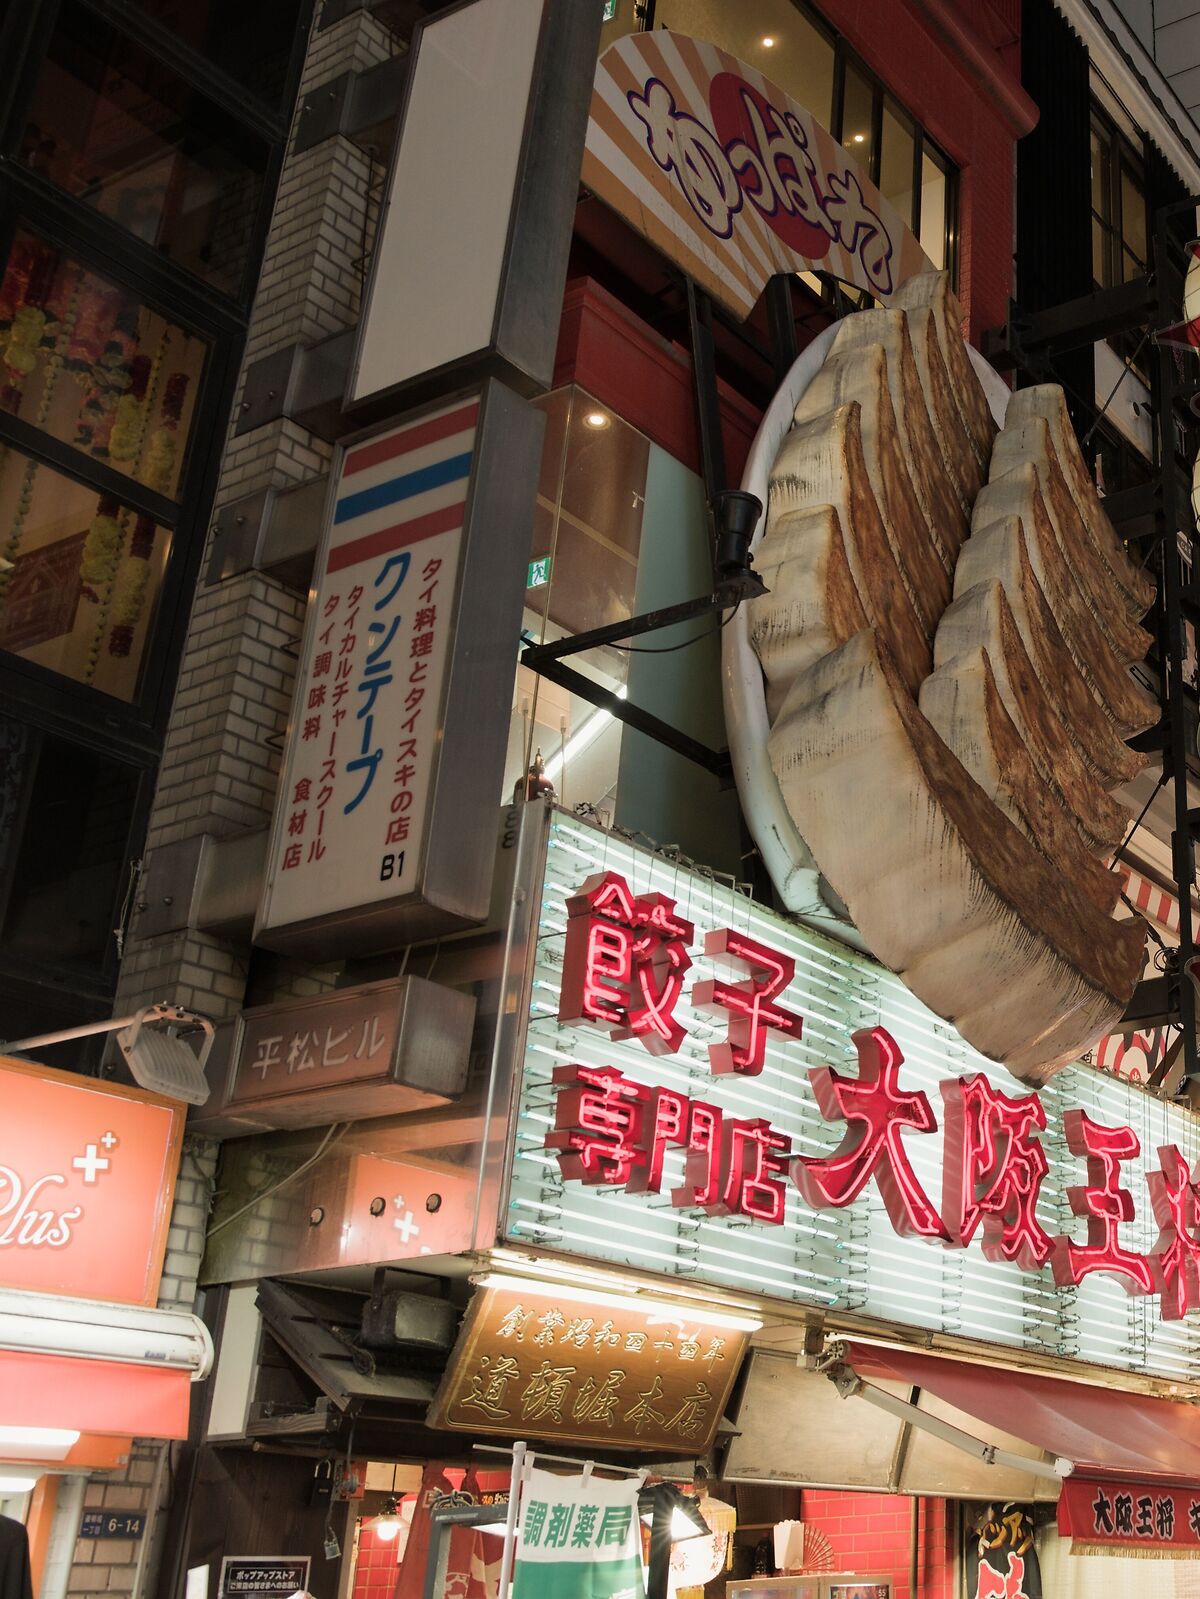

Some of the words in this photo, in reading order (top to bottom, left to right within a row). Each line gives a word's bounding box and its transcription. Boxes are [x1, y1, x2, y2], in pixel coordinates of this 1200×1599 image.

[302, 594, 341, 740] タイ調味料
[343, 551, 412, 817] クンテープ
[384, 558, 443, 846] タイ料理とタイスキの店
[306, 585, 364, 863] タイカルチャースクール
[282, 778, 313, 871] 食材店
[380, 852, 405, 882] B1
[557, 870, 804, 1077] 餃子
[252, 1016, 386, 1079] 平松ビル
[544, 1063, 792, 1226] 専門店
[460, 1354, 713, 1439] 道頓堀本店
[108, 1518, 139, 1533] 6-14
[522, 1500, 635, 1548] 調剤薬局
[1092, 1489, 1174, 1538] 大阪王将
[236, 1570, 296, 1580] ポップアップストア
